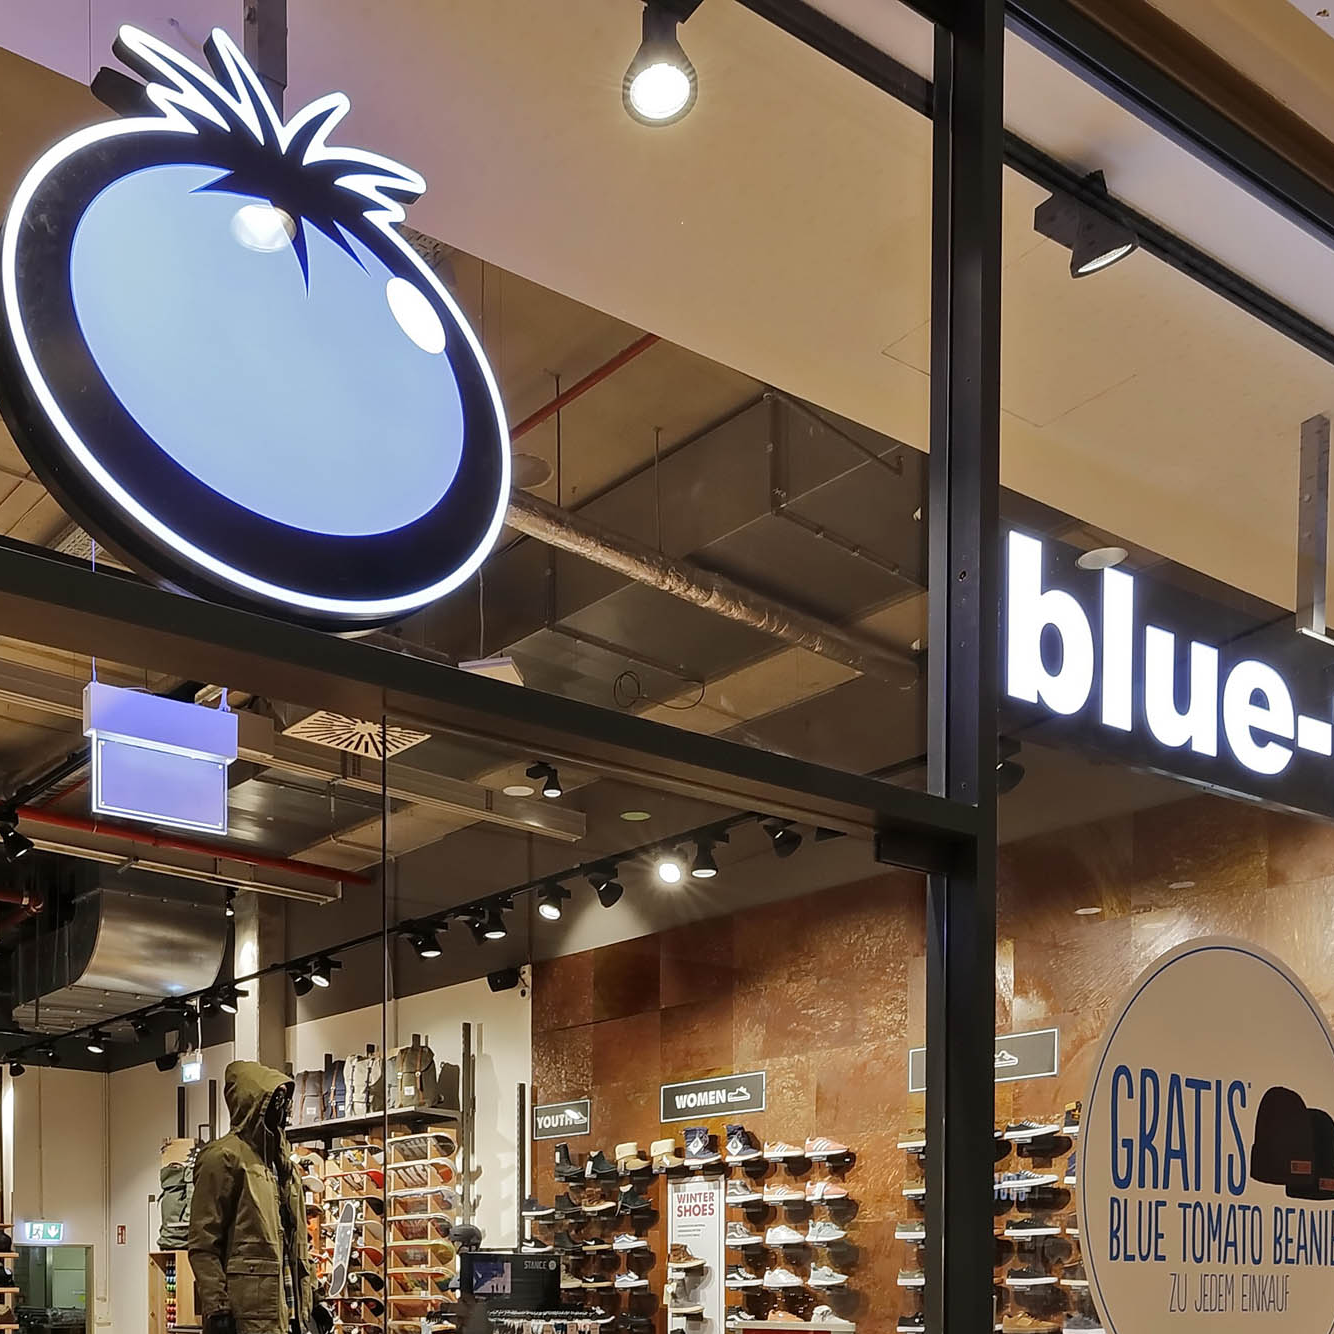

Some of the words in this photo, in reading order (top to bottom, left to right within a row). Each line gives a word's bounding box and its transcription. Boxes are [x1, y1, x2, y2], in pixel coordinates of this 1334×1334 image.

[675, 1088, 727, 1111] WOMEN
[536, 1112, 573, 1130] YOUTH
[677, 1191, 715, 1204] WINTER
[677, 1203, 715, 1217] SHOES
[1109, 1196, 1167, 1262] BLUE
[1178, 1200, 1263, 1266] TOMATO
[524, 1260, 547, 1270] STANCE
[1169, 1272, 1188, 1314] ZU
[1194, 1273, 1235, 1314] JEDEM
[1241, 1273, 1291, 1314] EINKAUF
